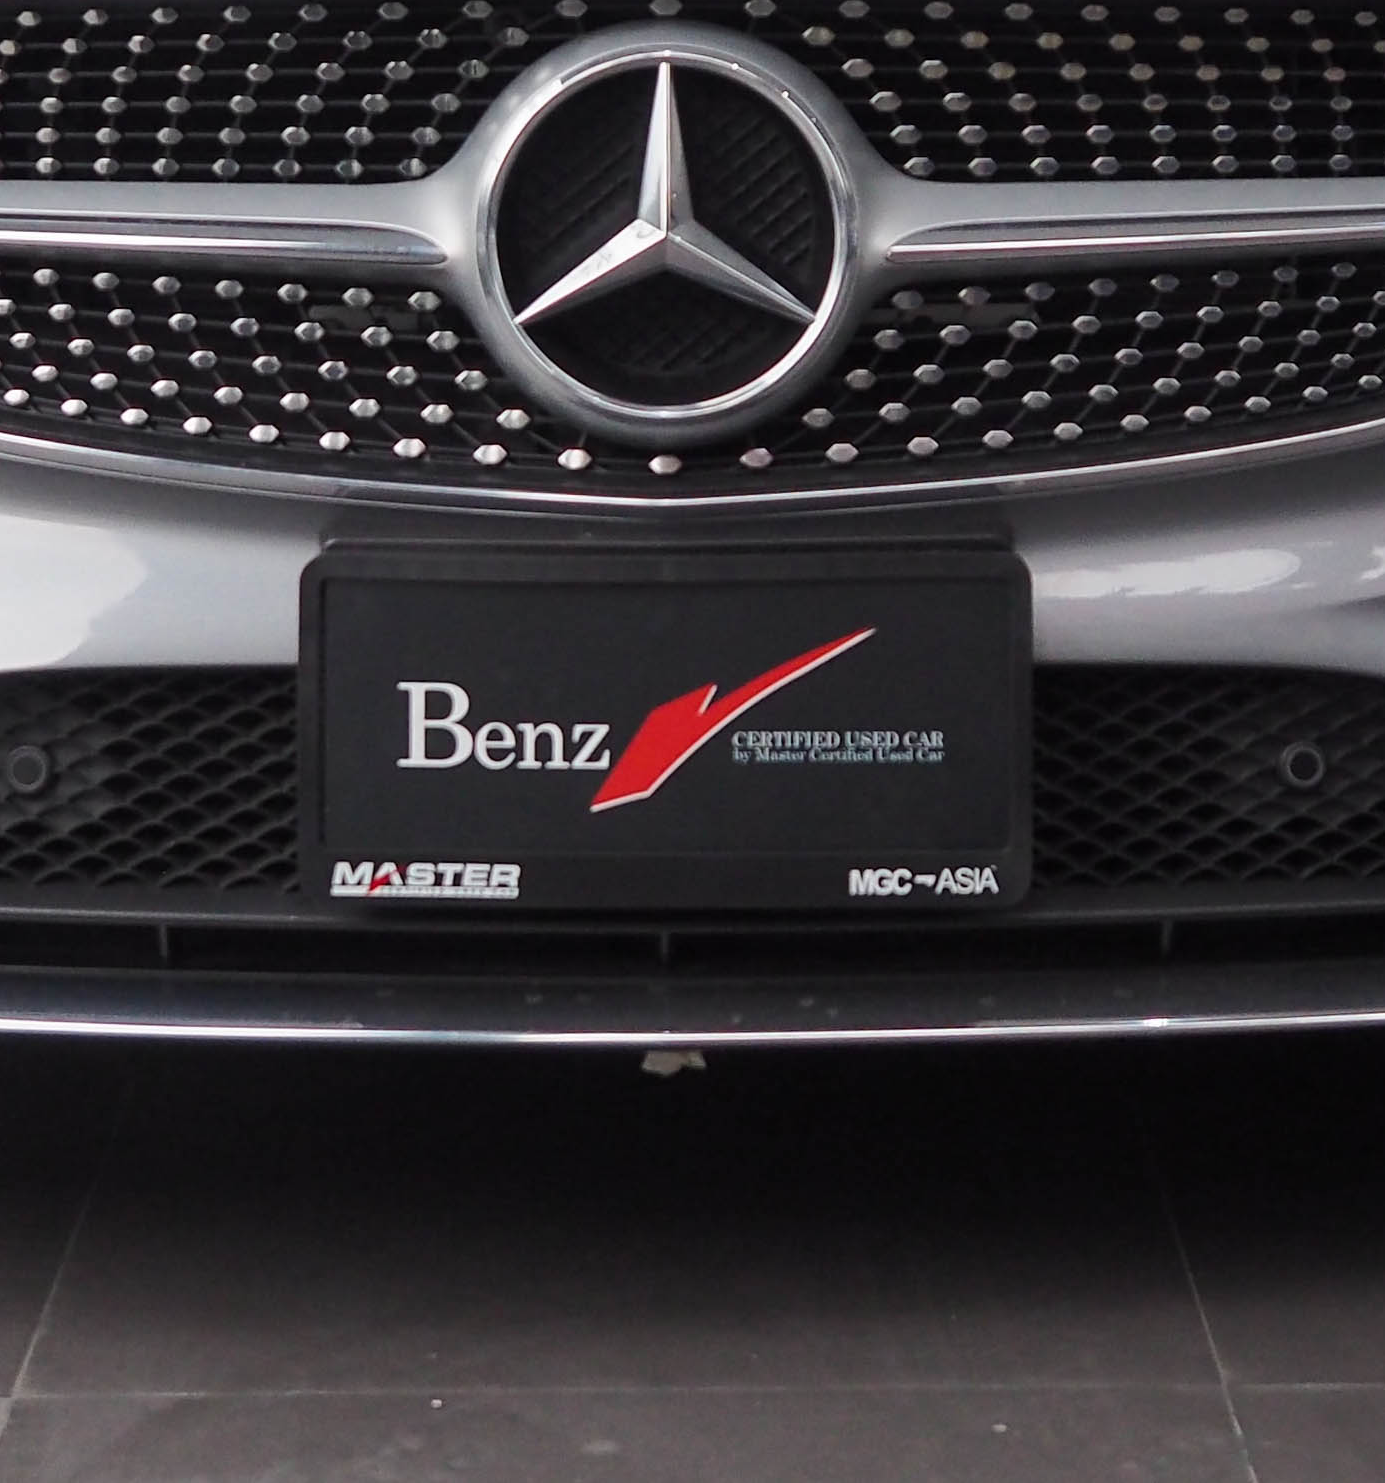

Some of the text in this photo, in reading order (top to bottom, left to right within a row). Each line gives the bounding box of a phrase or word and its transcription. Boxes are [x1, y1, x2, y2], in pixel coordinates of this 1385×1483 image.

[396, 681, 611, 770] Benz
[731, 730, 944, 749] CERTIFIED USED CAR
[732, 747, 944, 764] by Master Certified Used Car
[330, 861, 522, 887] MASTER
